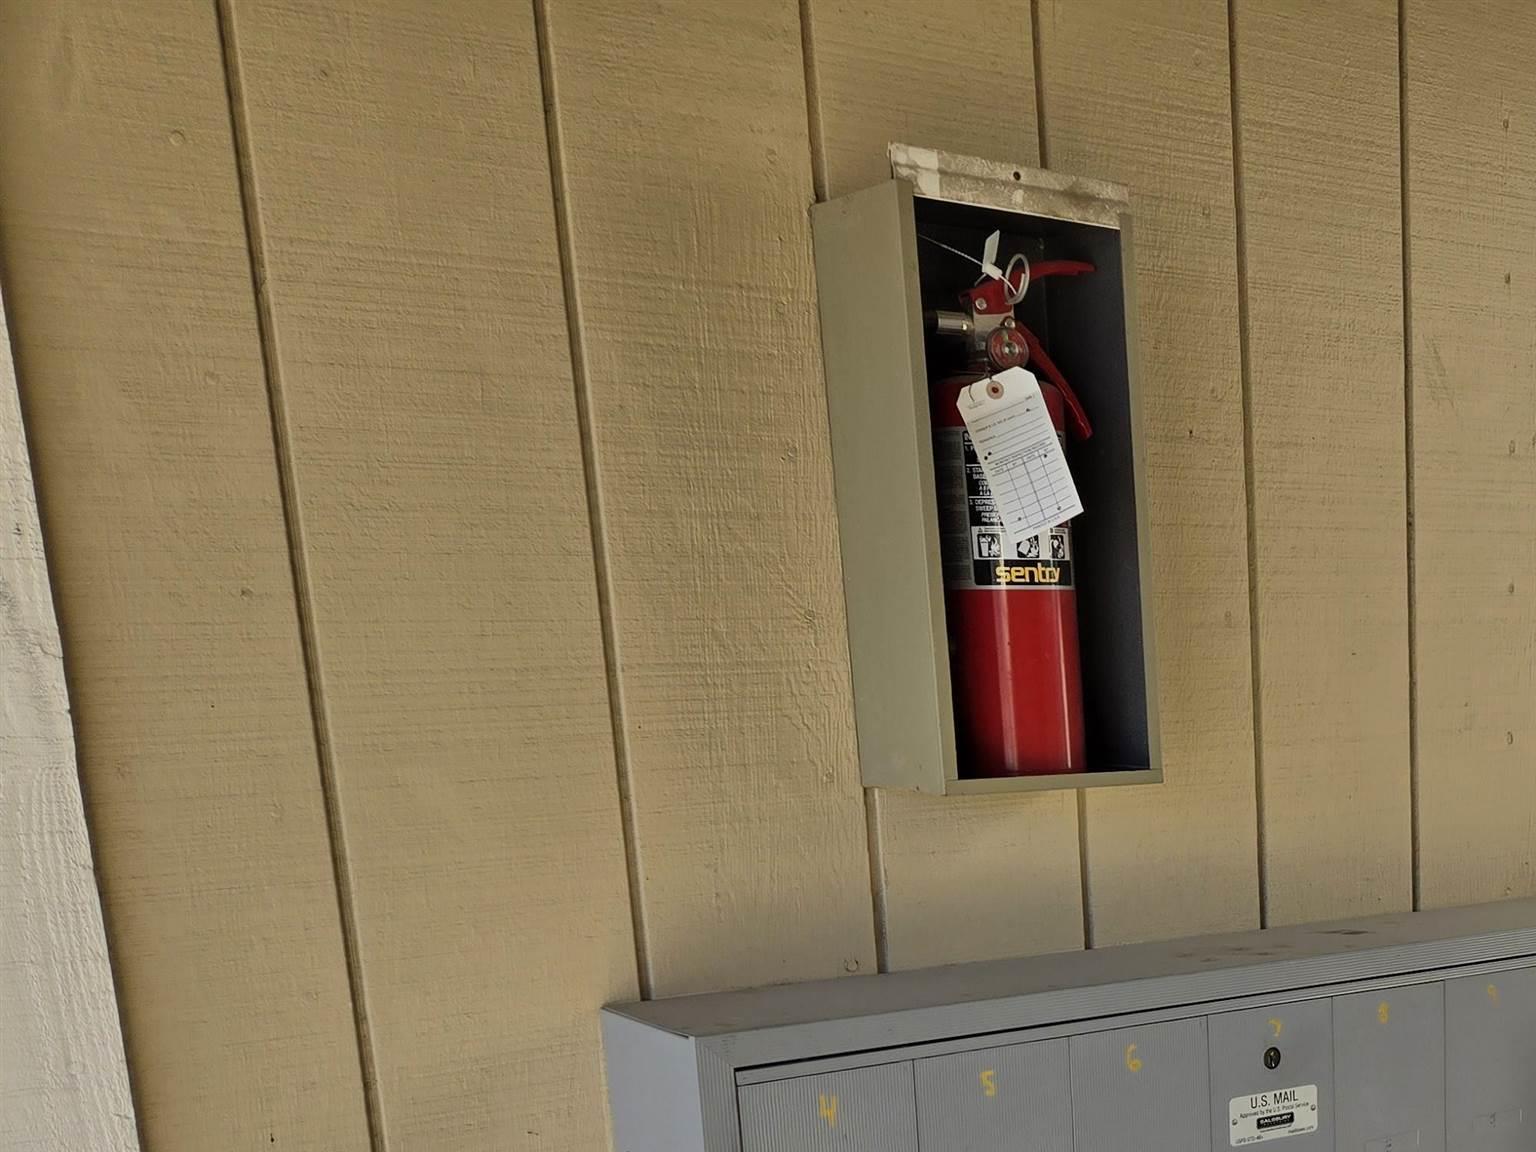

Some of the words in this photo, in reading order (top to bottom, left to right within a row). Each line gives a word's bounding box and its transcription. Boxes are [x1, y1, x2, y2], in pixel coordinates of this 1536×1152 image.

[995, 563, 1060, 583] sentry
[1125, 1044, 1143, 1072] 6
[979, 1070, 997, 1096] 5
[818, 1093, 838, 1129] 4
[1250, 1095, 1270, 1109] U.S.
[1273, 1090, 1298, 1104] MAIL
